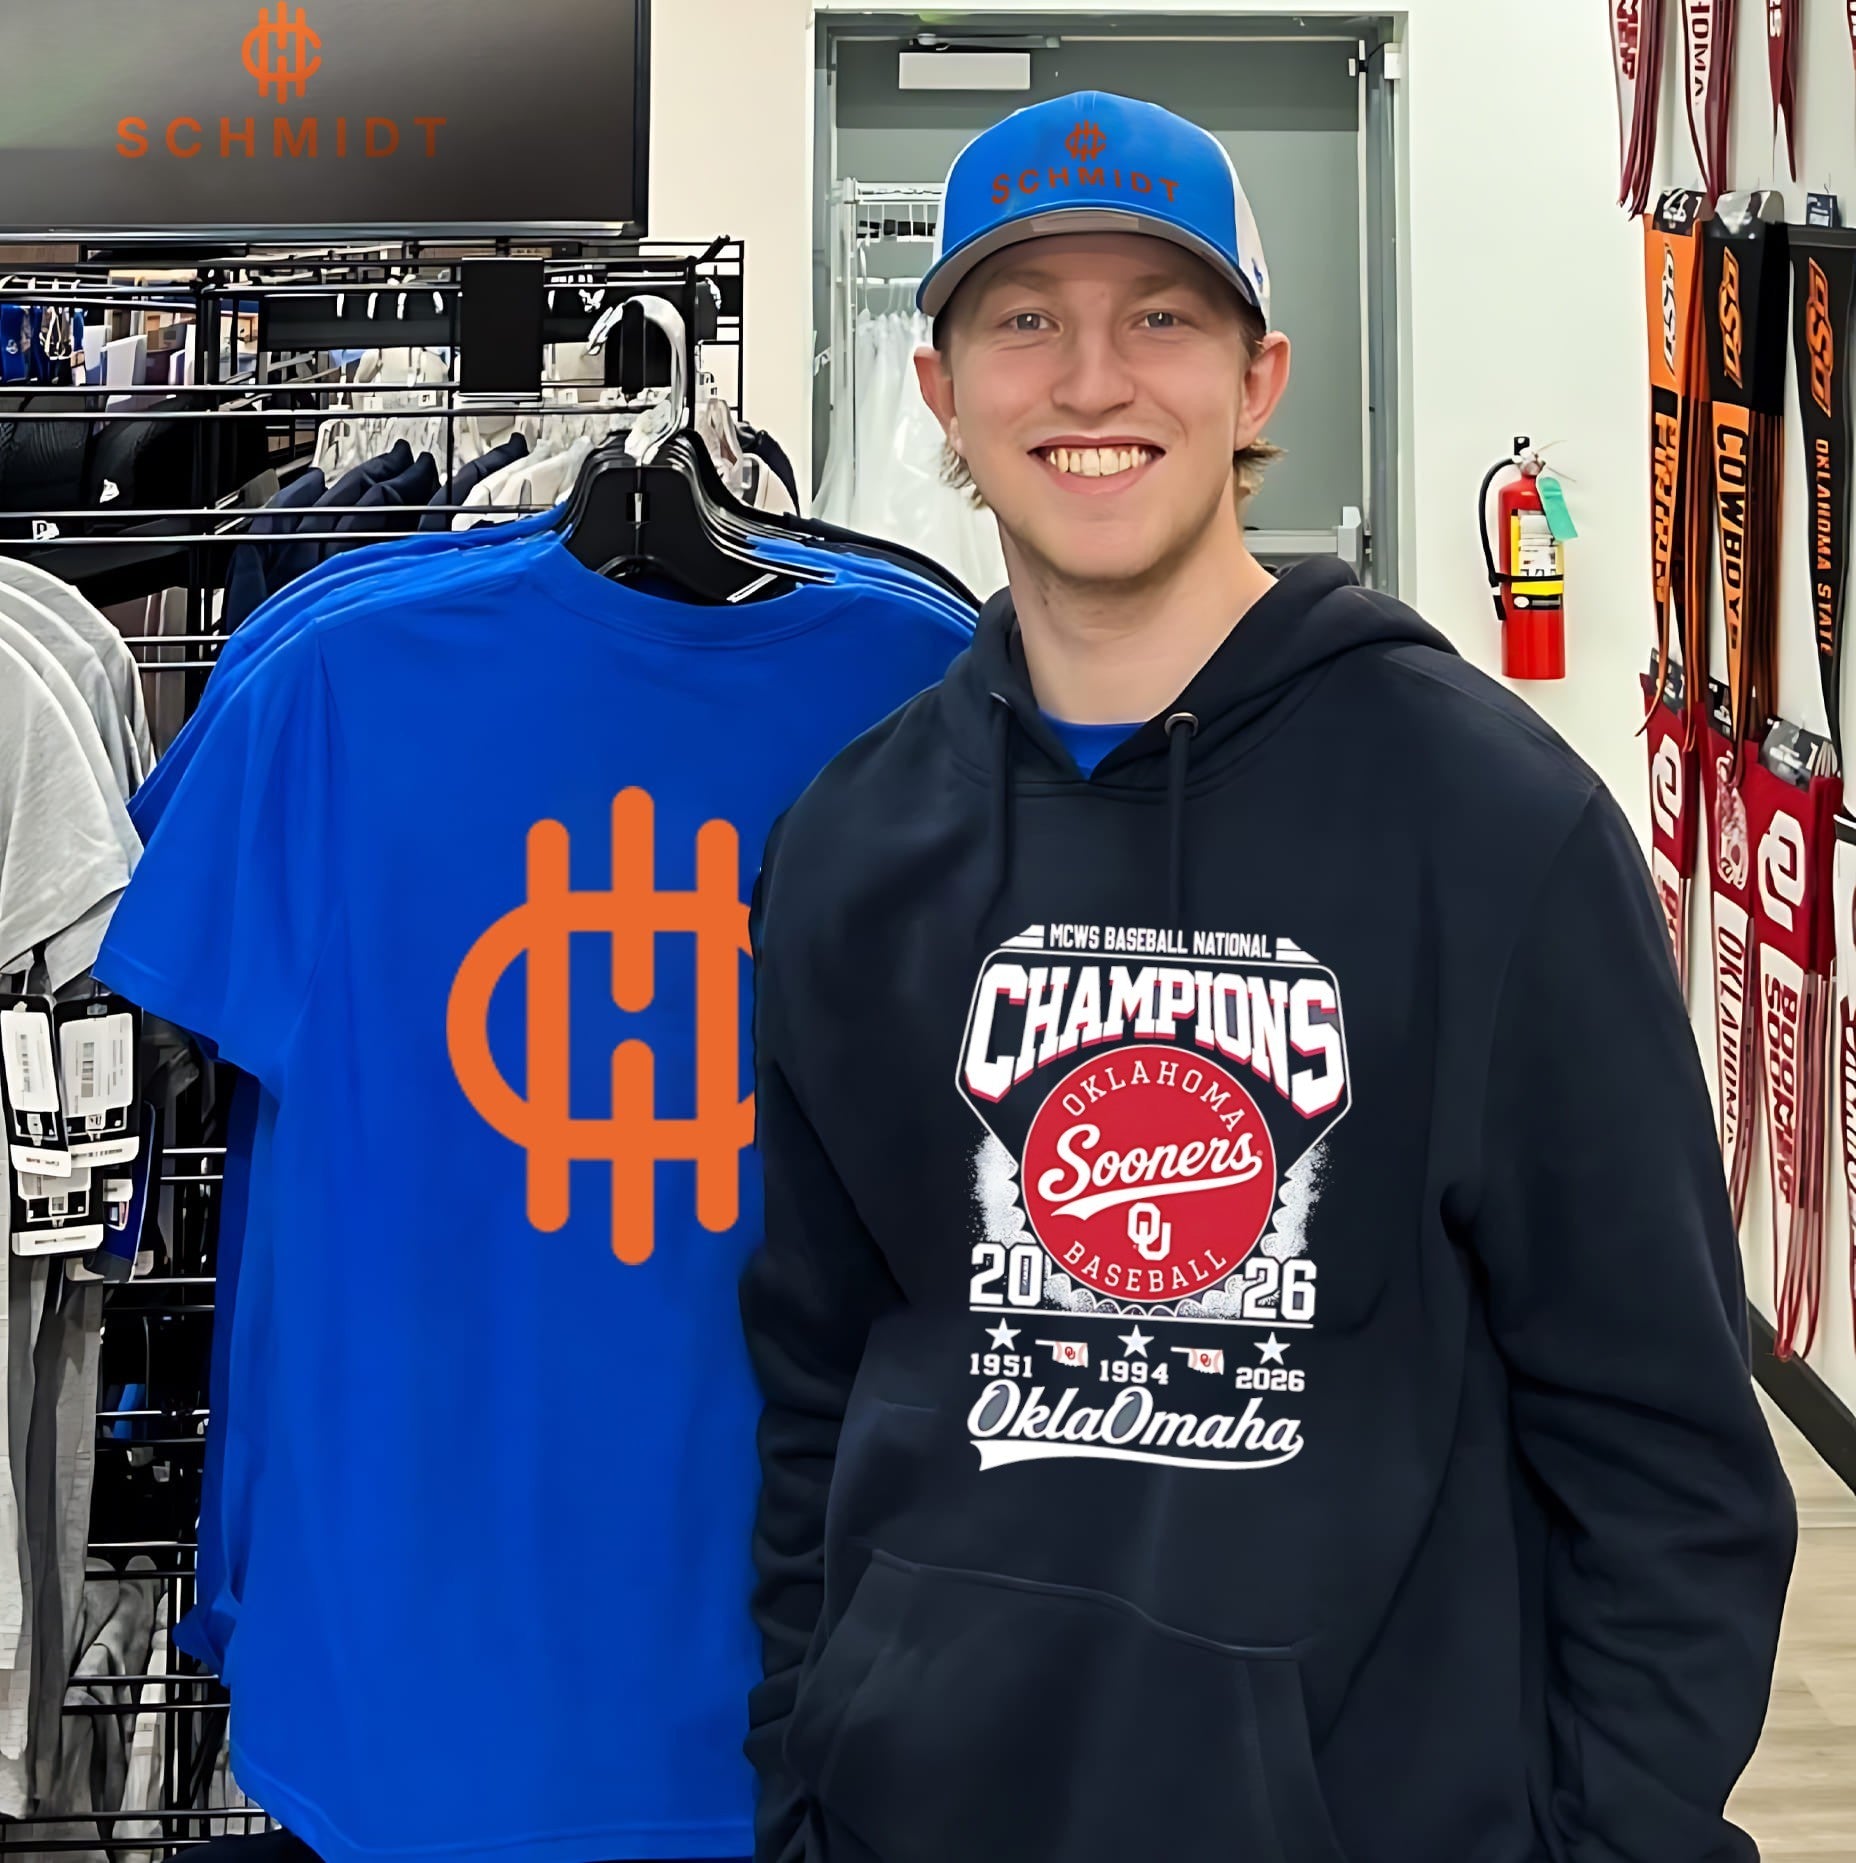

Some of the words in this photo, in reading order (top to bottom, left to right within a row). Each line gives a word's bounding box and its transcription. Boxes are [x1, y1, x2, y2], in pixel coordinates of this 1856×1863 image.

[115, 116, 447, 158] SCHMIDT
[991, 166, 1179, 204] SCHMIDT
[1815, 438, 1832, 570] OKLAHOMA
[1049, 923, 1100, 950] MCWS
[1104, 926, 1188, 954] BASEBALL
[1193, 931, 1272, 959] NATIONAL
[964, 963, 1346, 1120] CHAMPIONS
[1062, 1060, 1245, 1132] OKLAHOMA
[1038, 1123, 1258, 1202] Sooners
[1127, 1202, 1171, 1261] OU
[969, 1242, 1043, 1307] 20
[1242, 1256, 1317, 1321] 26
[1063, 1240, 1227, 1292] BASEBALL
[969, 1352, 1033, 1378] 1951
[1099, 1360, 1169, 1385] 1994
[1235, 1366, 1305, 1392] 2026
[967, 1379, 1304, 1452] OklaOmaha
